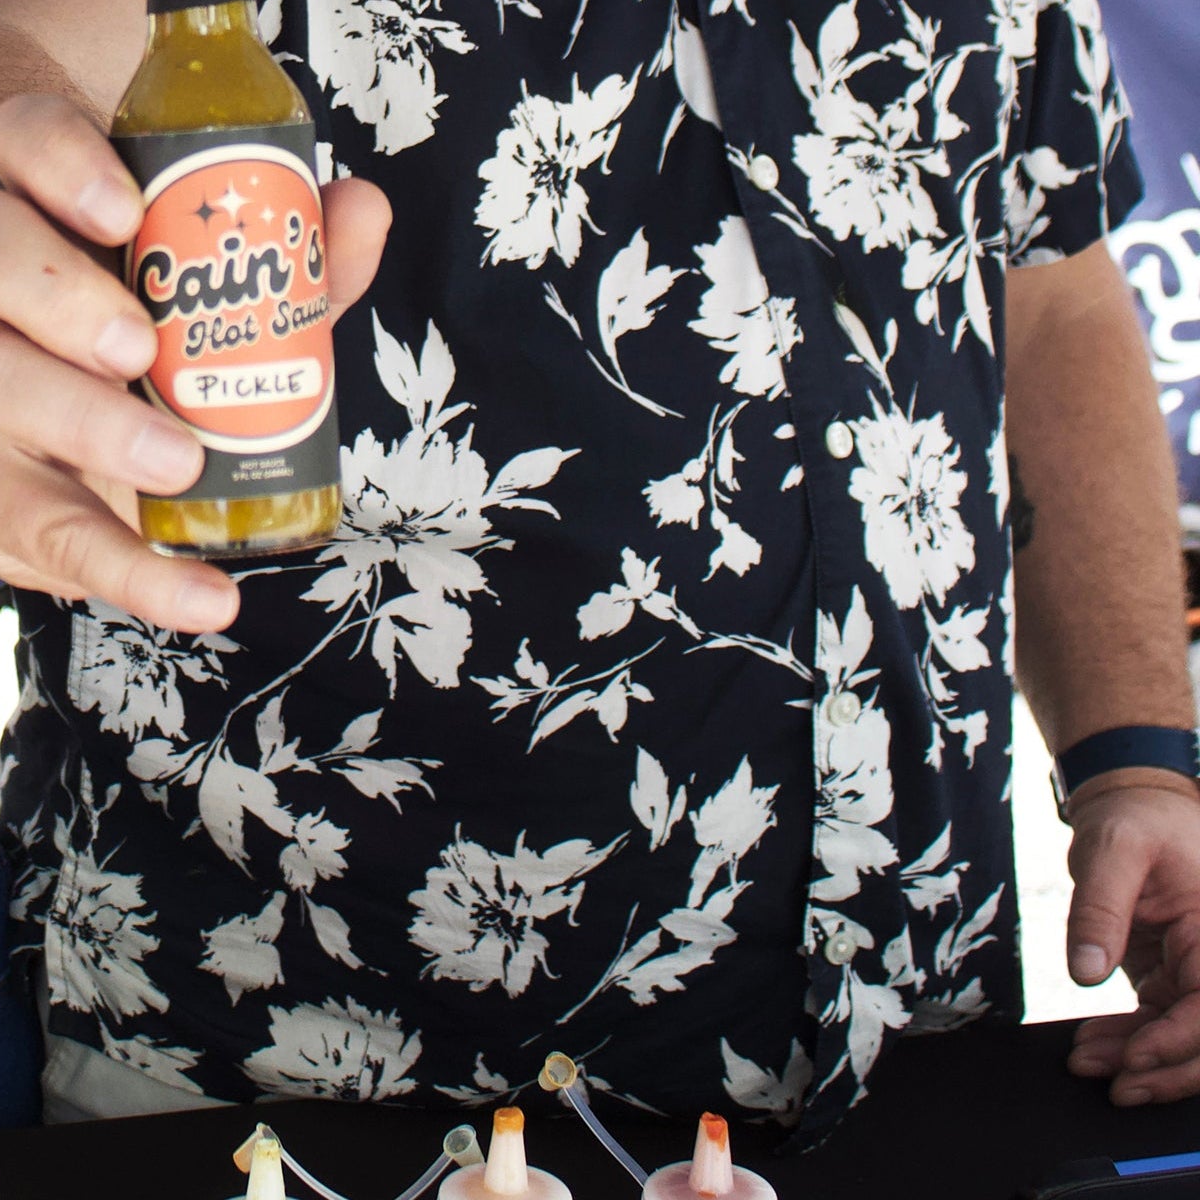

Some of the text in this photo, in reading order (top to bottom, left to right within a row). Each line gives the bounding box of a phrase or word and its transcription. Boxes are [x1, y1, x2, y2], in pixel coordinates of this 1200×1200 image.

[136, 214, 325, 324] Cain's
[184, 312, 260, 357] Hot
[195, 368, 306, 401] PICKLE
